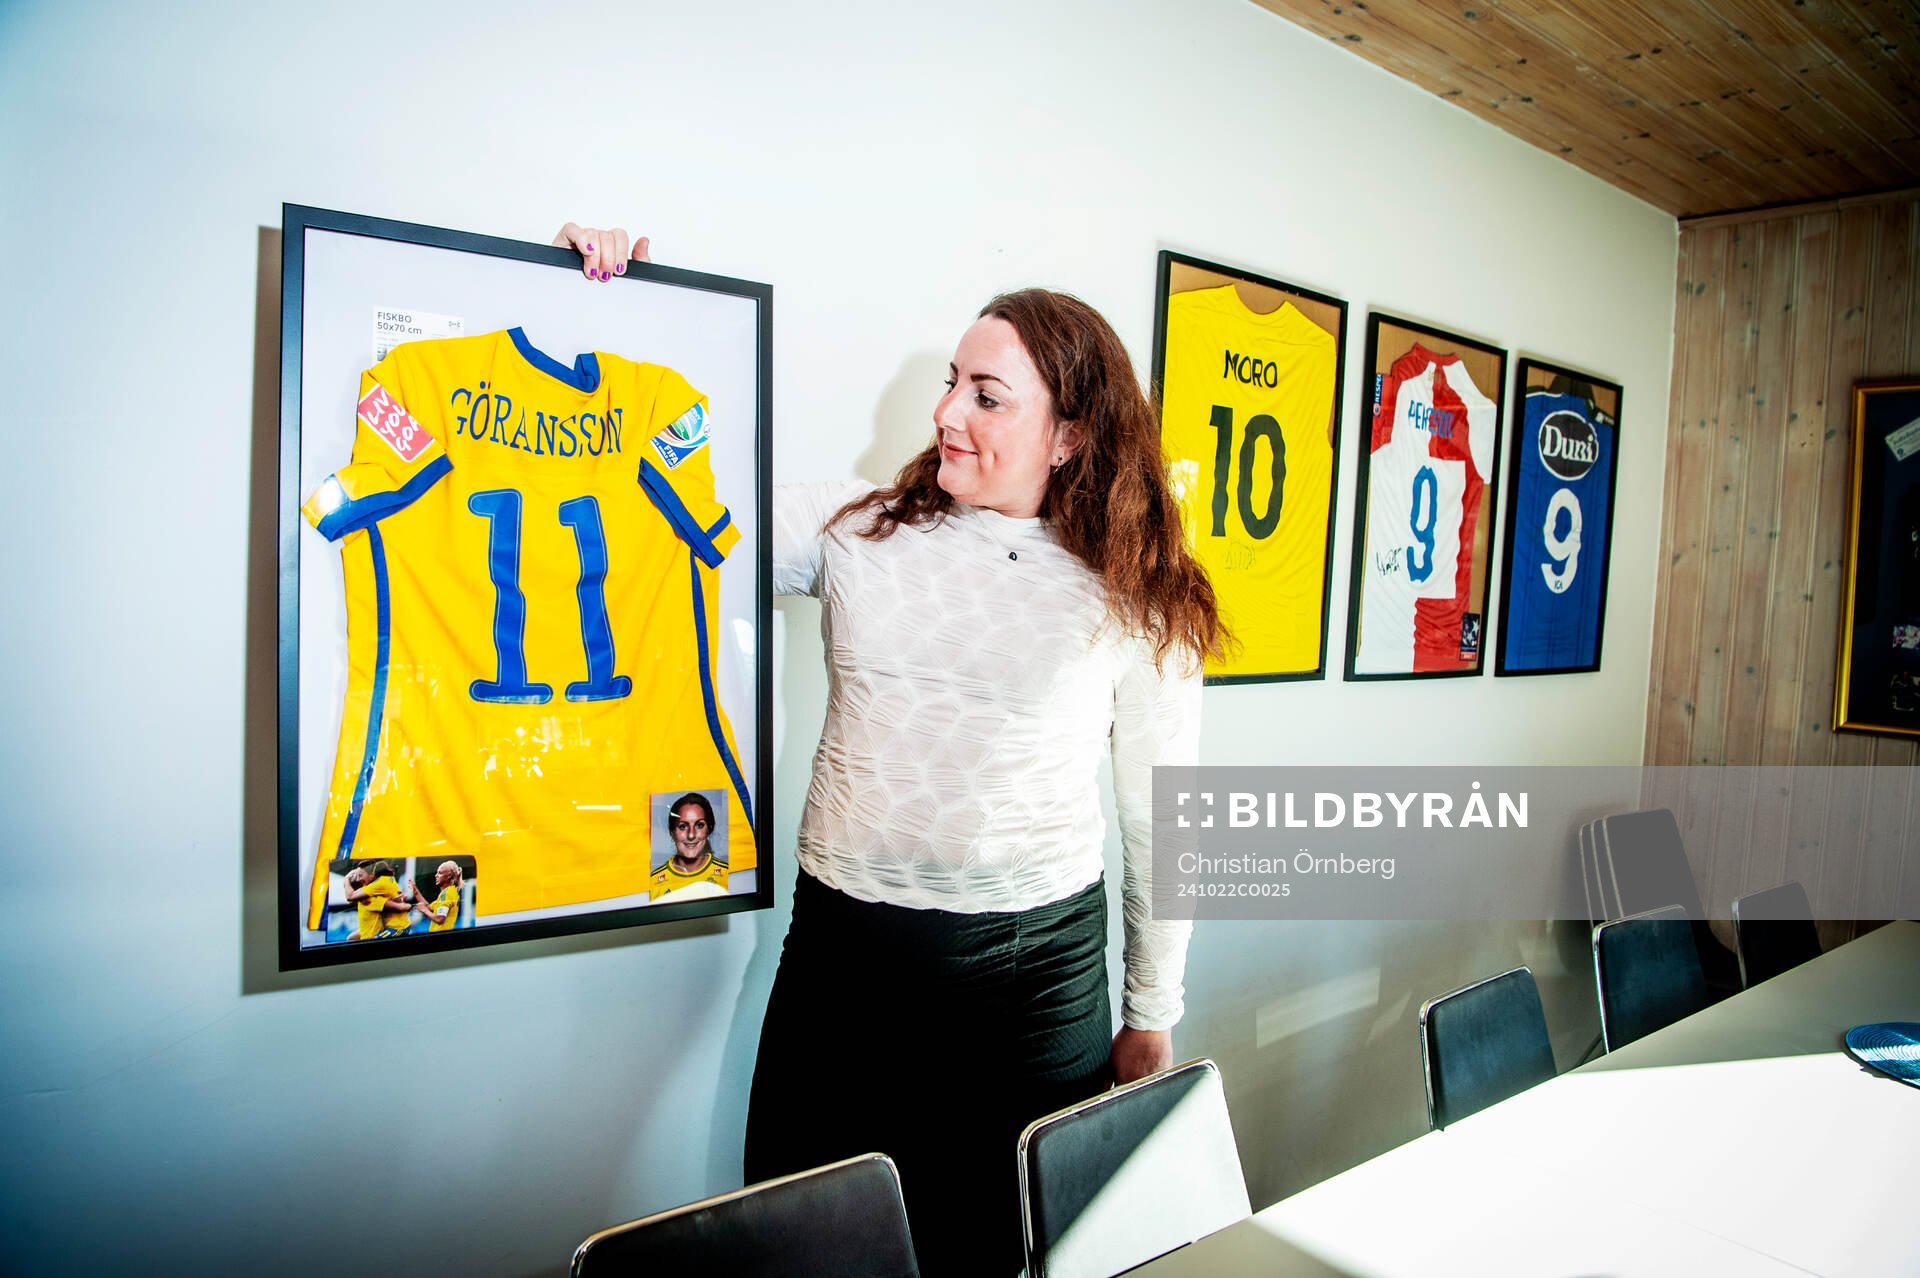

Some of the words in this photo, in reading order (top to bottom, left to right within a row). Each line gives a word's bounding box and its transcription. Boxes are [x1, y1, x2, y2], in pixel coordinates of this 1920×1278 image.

[377, 311, 412, 323] FISKBO
[377, 321, 405, 333] 50x70
[407, 326, 422, 335] cm
[1223, 349, 1278, 389] MORO
[663, 444, 679, 465] FIFA
[1542, 423, 1594, 463] Duni
[1209, 404, 1287, 540] 10
[1406, 465, 1438, 583] 9
[1541, 488, 1582, 594] 9
[467, 488, 633, 705] 11
